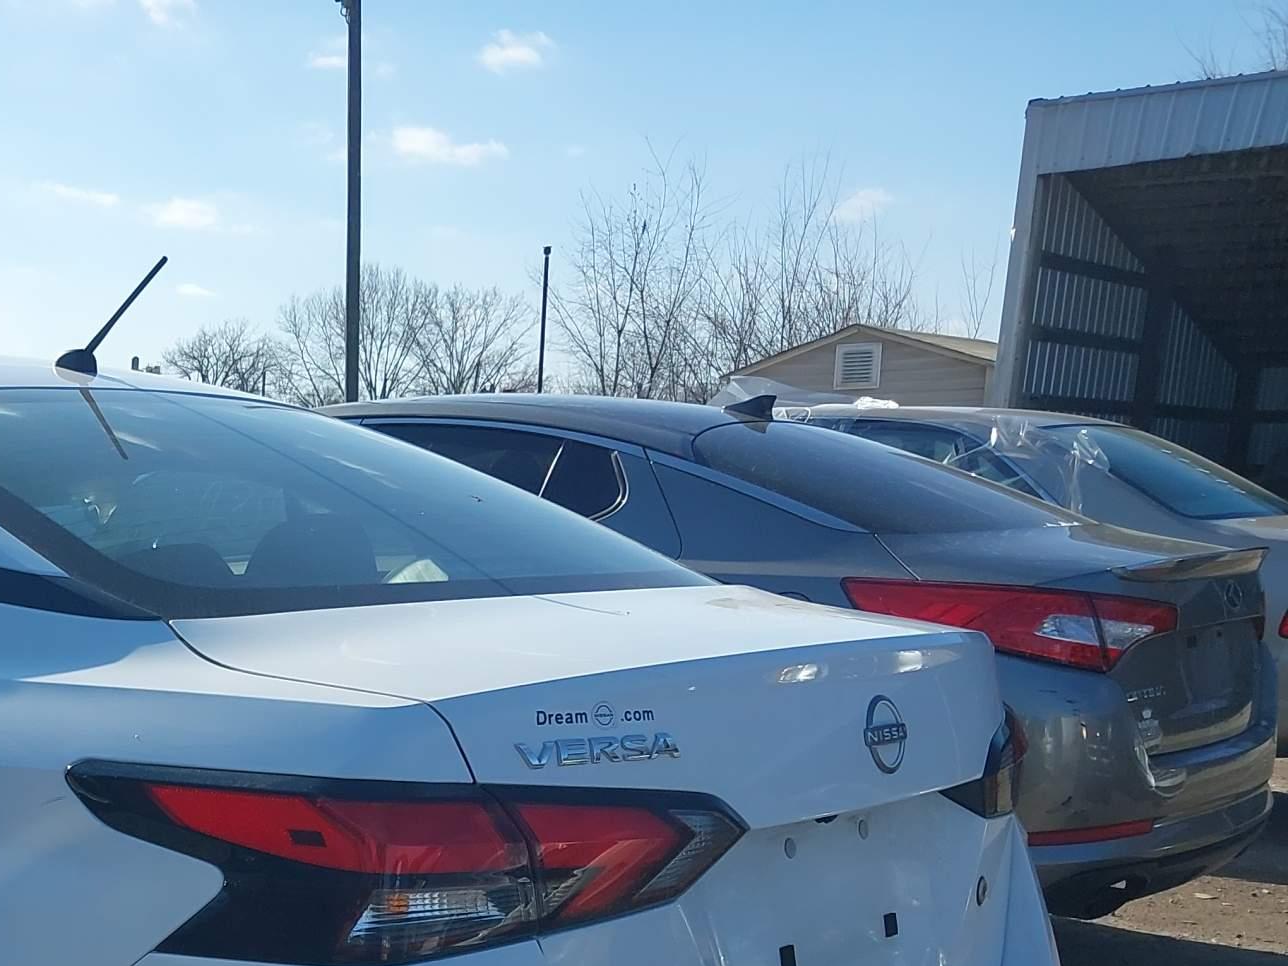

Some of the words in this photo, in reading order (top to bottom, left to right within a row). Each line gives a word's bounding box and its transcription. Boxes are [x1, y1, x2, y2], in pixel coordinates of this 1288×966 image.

[535, 710, 589, 726] Dream
[620, 708, 655, 723] .com
[866, 725, 906, 743] NISSA
[513, 731, 681, 770] VERSA
